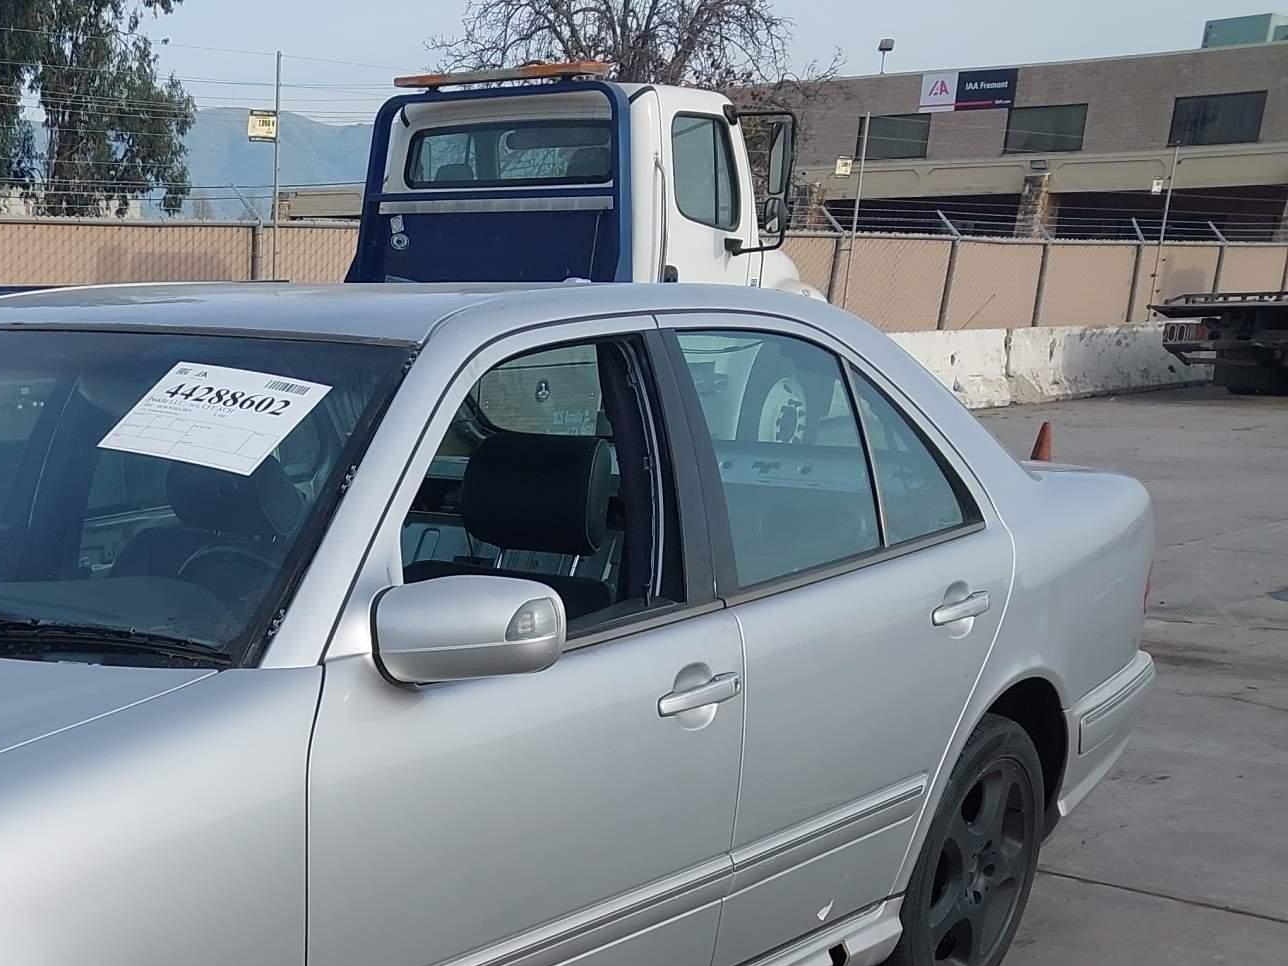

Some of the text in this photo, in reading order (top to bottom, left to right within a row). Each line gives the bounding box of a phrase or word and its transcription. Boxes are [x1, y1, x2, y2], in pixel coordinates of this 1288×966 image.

[965, 81, 1009, 90] IAA Fremont
[165, 382, 292, 417] 44288602
